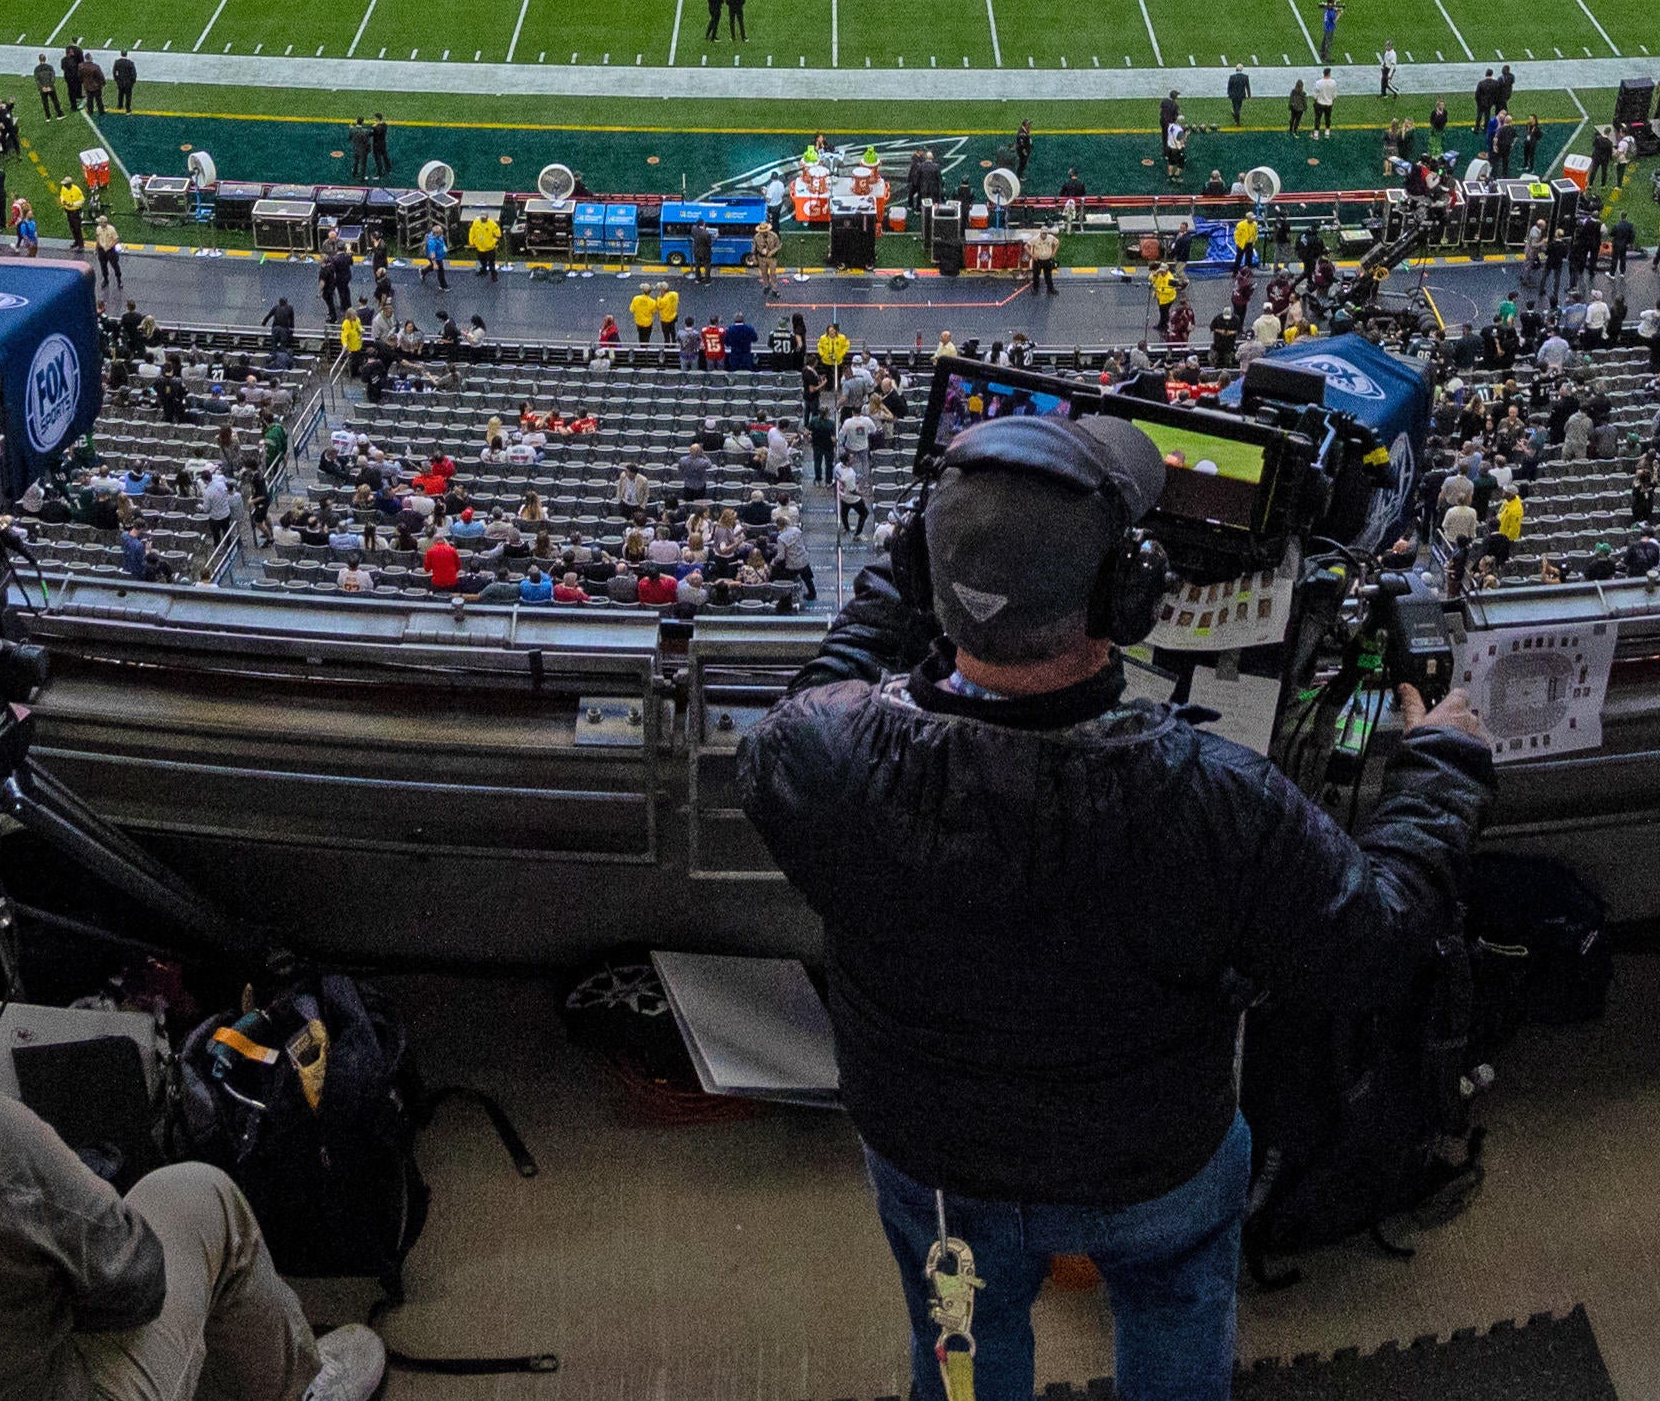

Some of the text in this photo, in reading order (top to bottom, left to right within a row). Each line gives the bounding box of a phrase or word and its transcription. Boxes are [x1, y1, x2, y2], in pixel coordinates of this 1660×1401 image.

[706, 337, 721, 353] 15
[773, 339, 791, 355] 20
[36, 351, 70, 416] FOX
[41, 394, 71, 436] SPORTS
